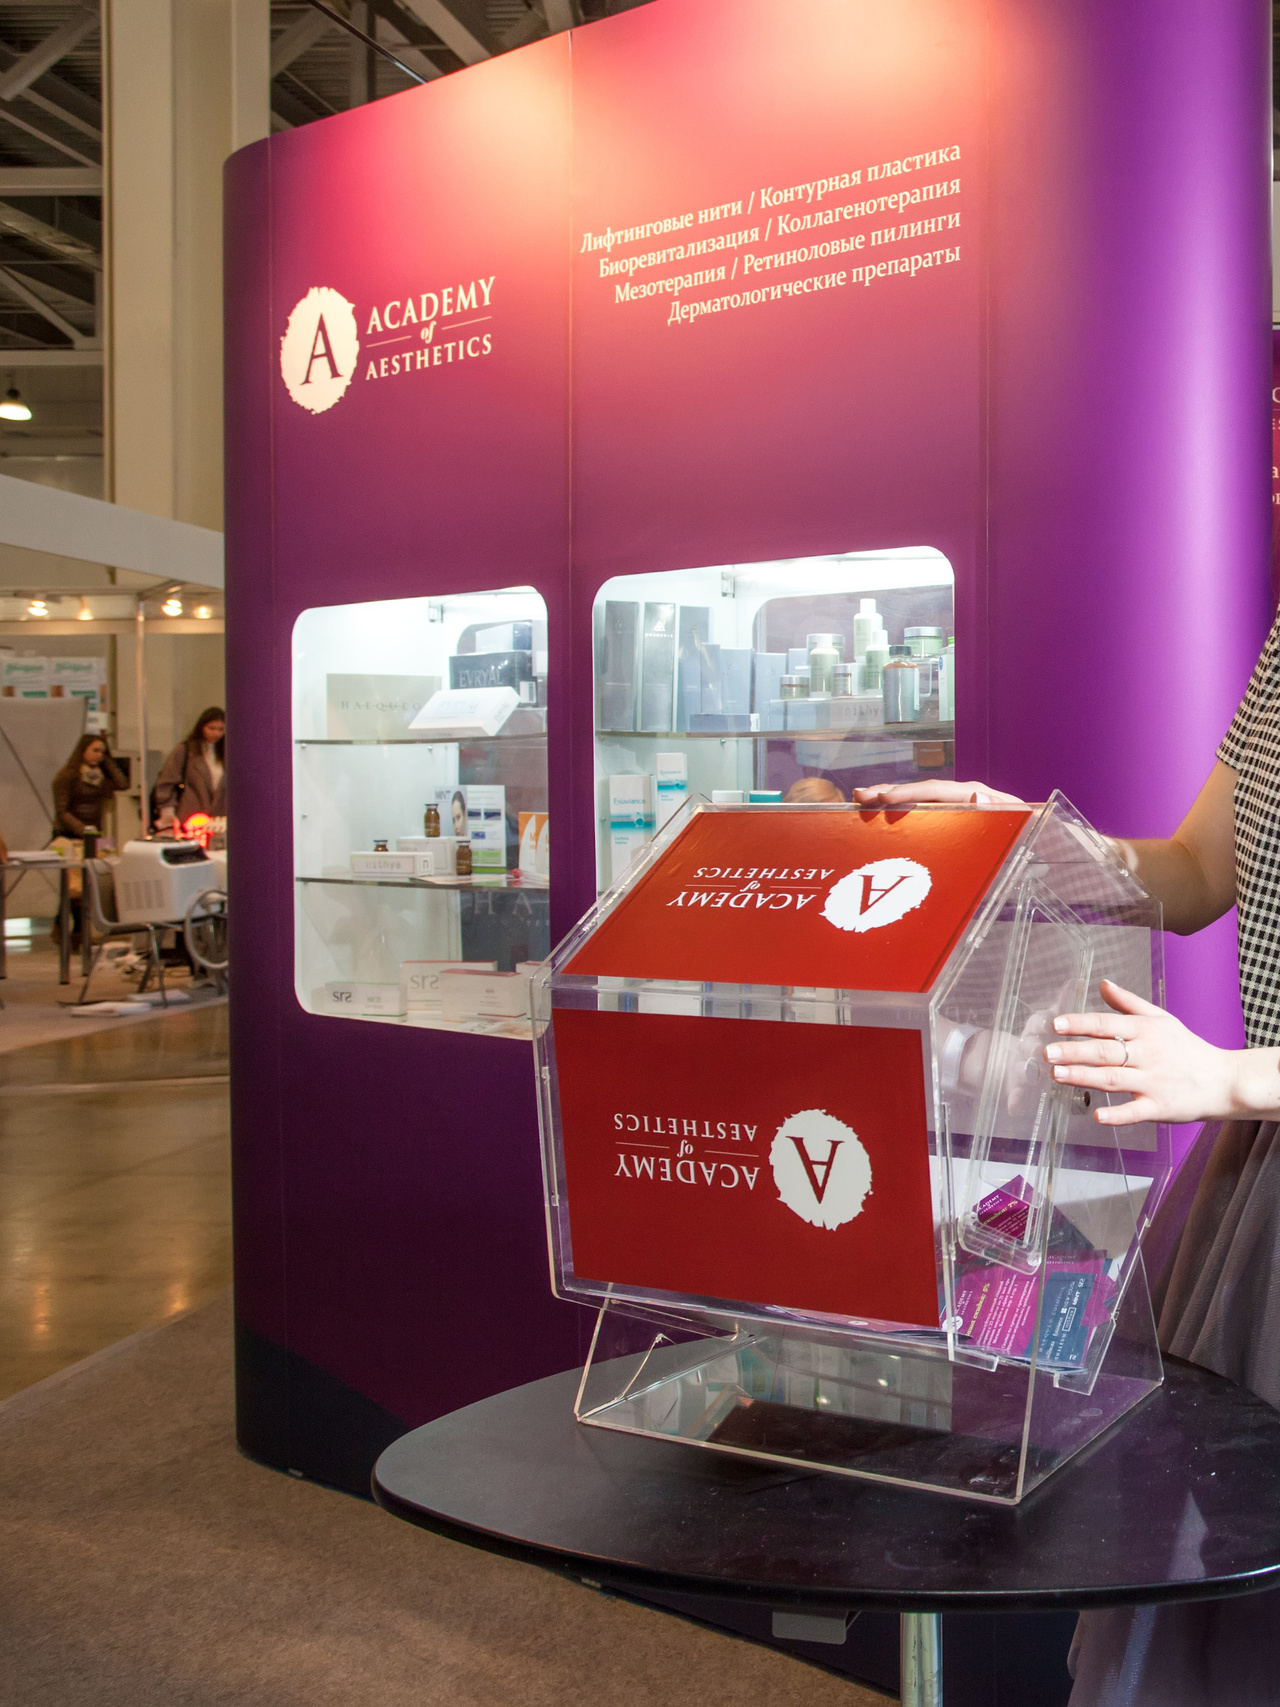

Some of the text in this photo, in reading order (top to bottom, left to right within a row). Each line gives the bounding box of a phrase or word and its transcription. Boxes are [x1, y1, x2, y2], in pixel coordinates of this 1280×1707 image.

[580, 212, 694, 253] Лифтинговые
[698, 201, 743, 225] нити
[760, 170, 862, 209] Контурная
[867, 144, 961, 182] пластика
[599, 227, 760, 278] Биоревитализация
[777, 178, 961, 236] Коллагенотерапия
[614, 265, 726, 304] Мезотерапия
[743, 233, 866, 275] Ретиноловые
[870, 212, 961, 246] пилинги
[366, 276, 496, 335] ACADEMY
[667, 246, 961, 327] Дерматологические препараты
[420, 320, 437, 344] of
[365, 333, 492, 380] AESTHETICS
[693, 867, 835, 880] AESTHETICS
[740, 880, 761, 892] of
[666, 891, 817, 910] ACADEMY
[613, 1112, 758, 1142] AESTHETICS
[676, 1139, 694, 1158] of
[614, 1153, 760, 1191] ACADEMY
